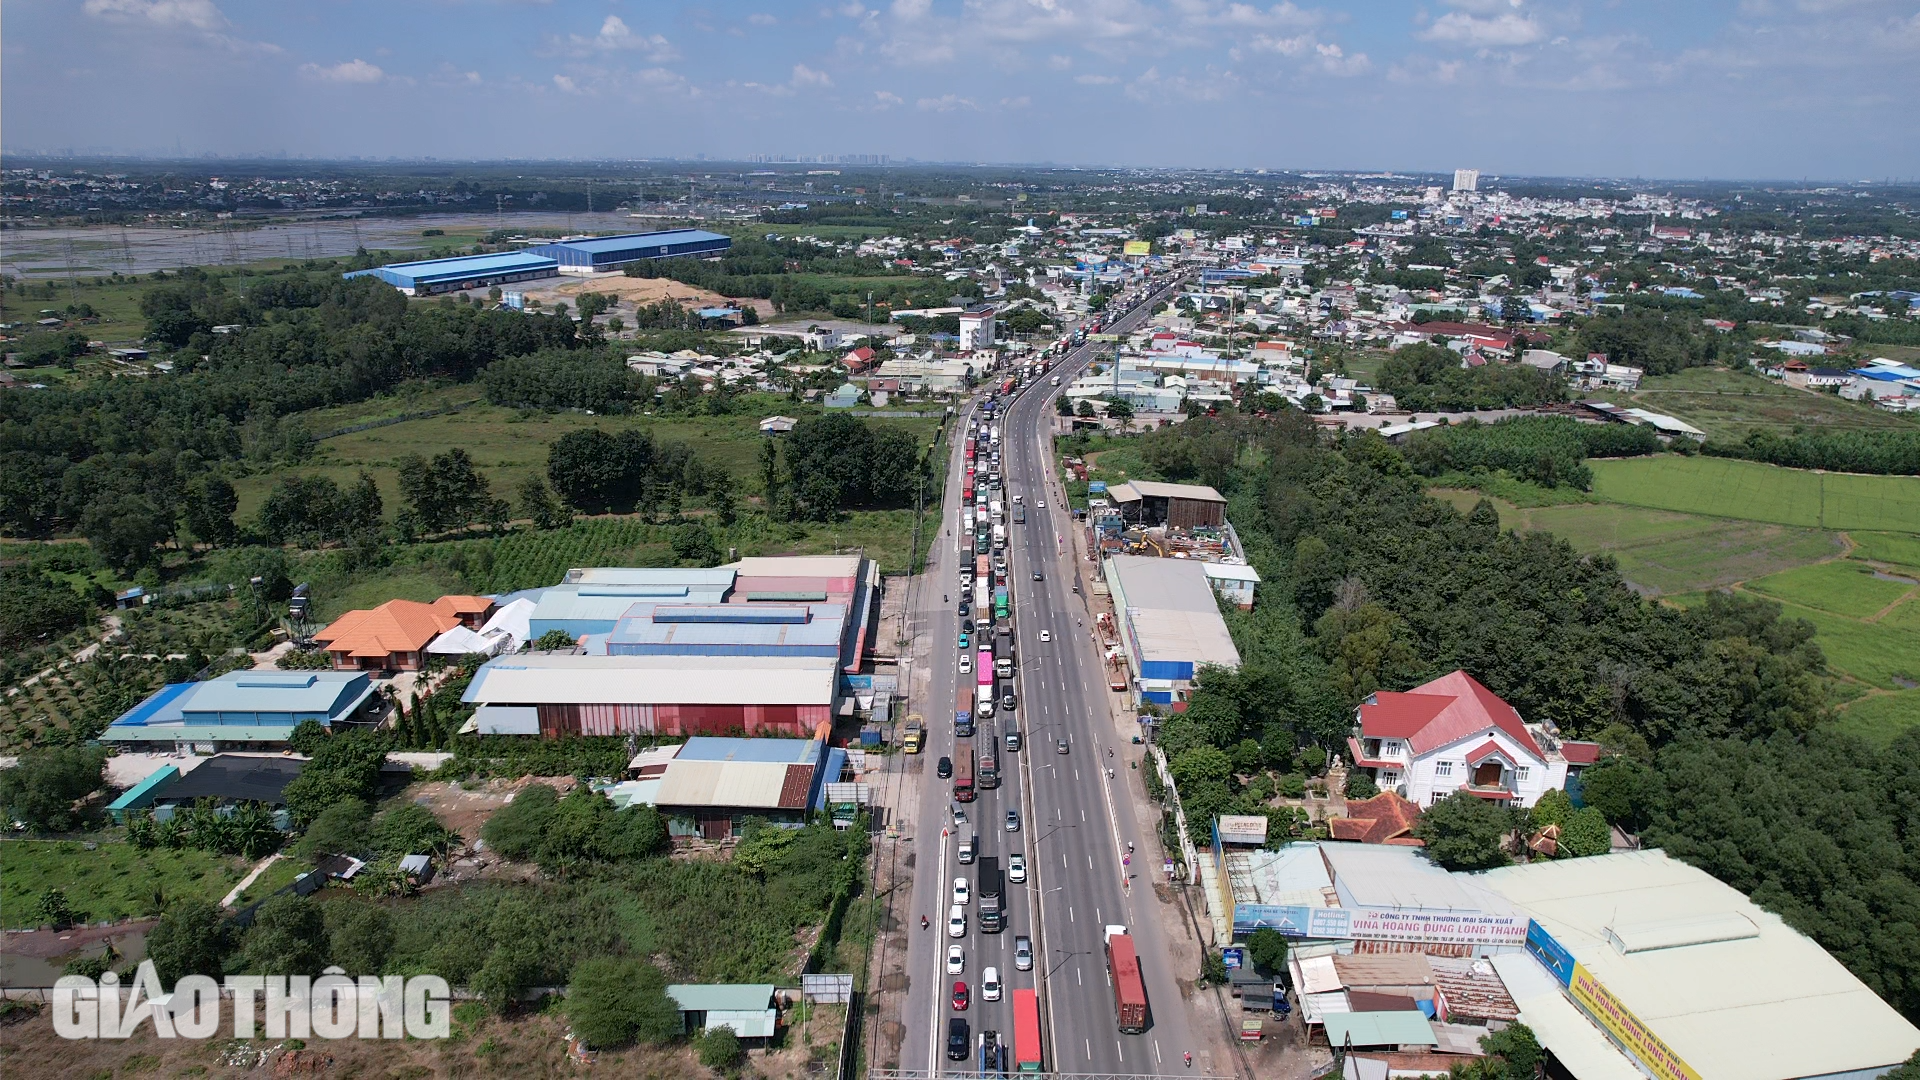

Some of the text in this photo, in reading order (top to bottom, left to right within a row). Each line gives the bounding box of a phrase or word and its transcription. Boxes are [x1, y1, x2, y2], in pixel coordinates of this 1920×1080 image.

[1318, 911, 1346, 919] Hotline
[1380, 912, 1400, 920] CÔNG
[1353, 920, 1379, 930] VINA
[1458, 925, 1487, 934] LONG
[1578, 975, 1594, 997] VINA
[1643, 1037, 1664, 1063] LONG
